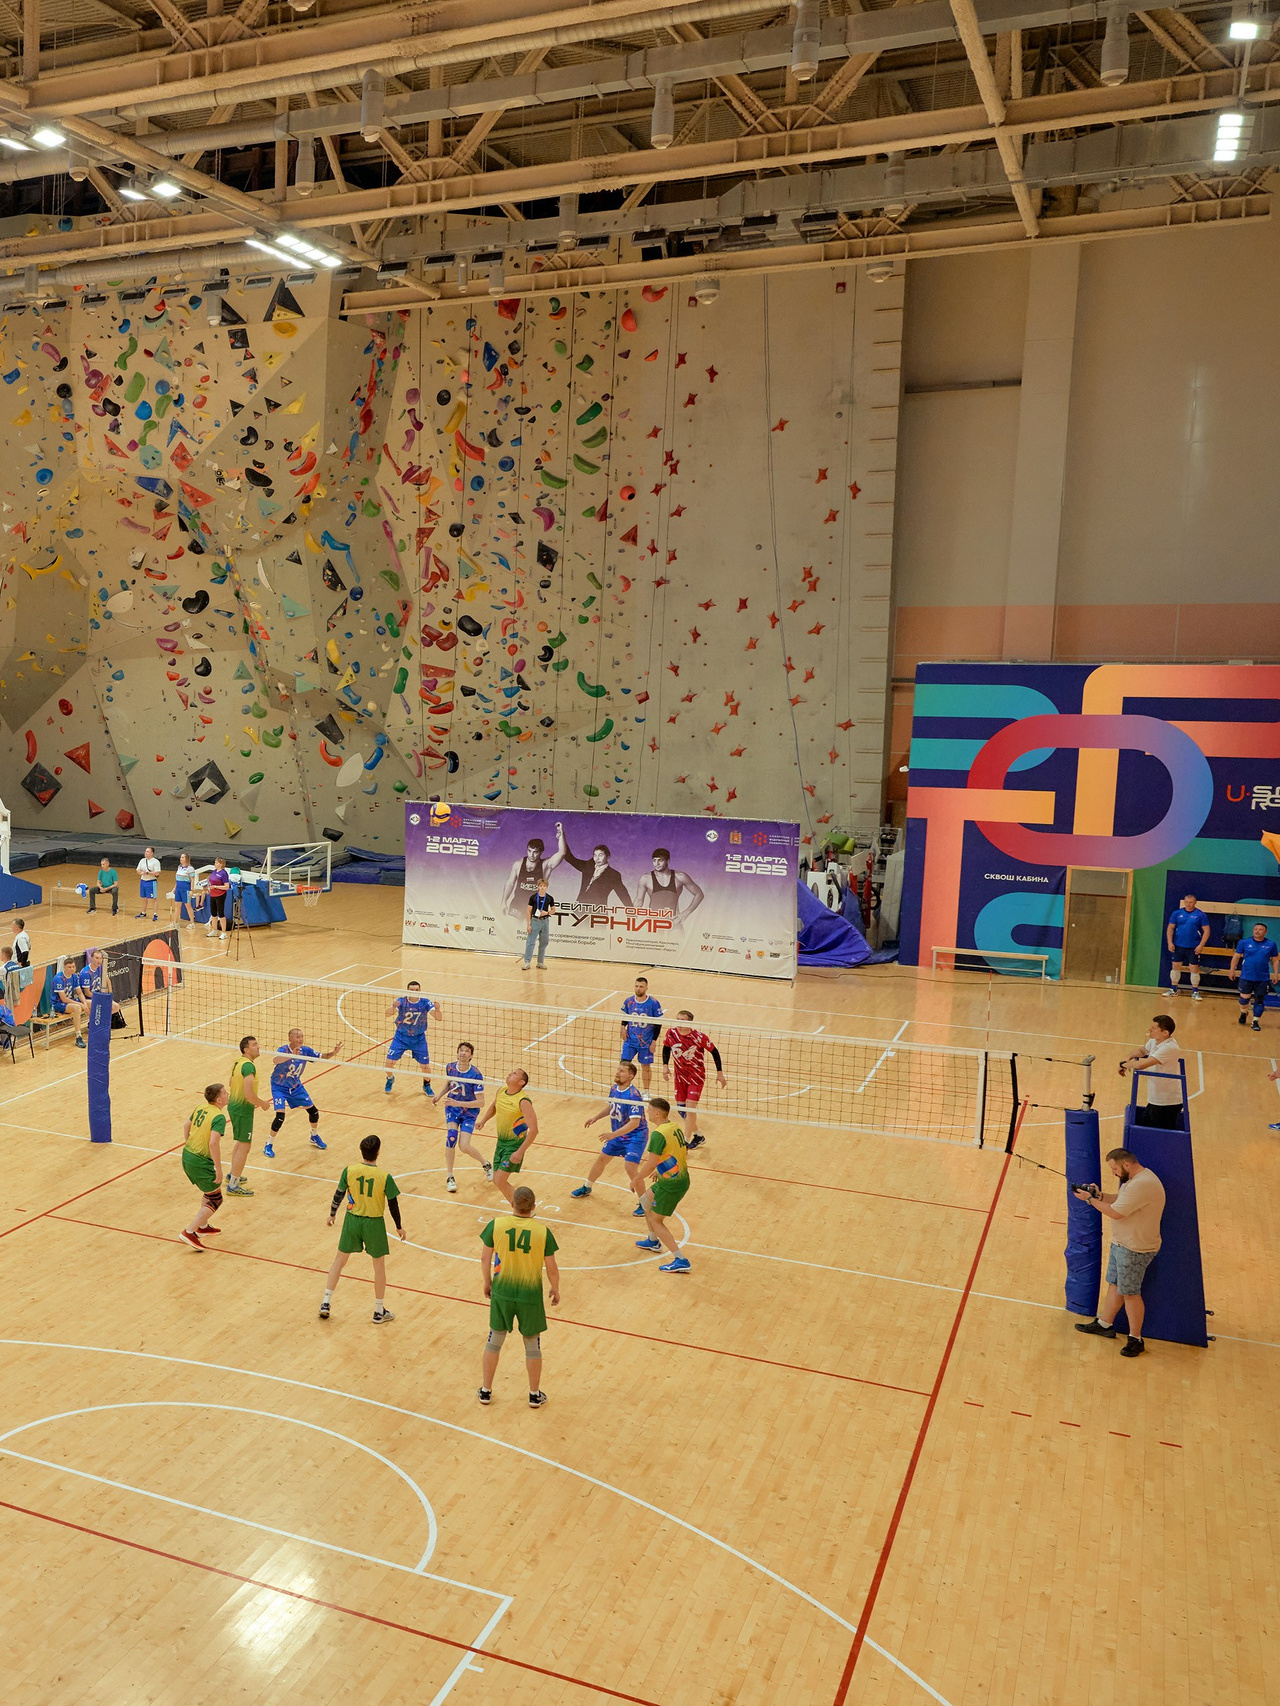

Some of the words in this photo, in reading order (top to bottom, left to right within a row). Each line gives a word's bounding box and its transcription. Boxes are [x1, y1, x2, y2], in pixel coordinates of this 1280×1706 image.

[426, 835, 440, 843] 1-2
[442, 837, 479, 846] МАРТА
[426, 842, 479, 857] 2025
[725, 853, 742, 861] 1-2
[744, 855, 788, 865] МАРТА
[725, 861, 787, 877] 2025
[984, 873, 1015, 881] СКВОШ
[1016, 875, 1049, 883] КАБИНА
[552, 912, 672, 933] ТУРНИР
[403, 1011, 422, 1026] 27
[671, 1043, 697, 1060] 64
[287, 1063, 303, 1078] 24
[450, 1081, 466, 1097] 21
[610, 1103, 621, 1122] 25
[631, 1105, 639, 1113] 25
[193, 1109, 208, 1128] 15
[673, 1129, 686, 1149] 10
[356, 1175, 375, 1198] 11
[505, 1227, 532, 1254] 14
